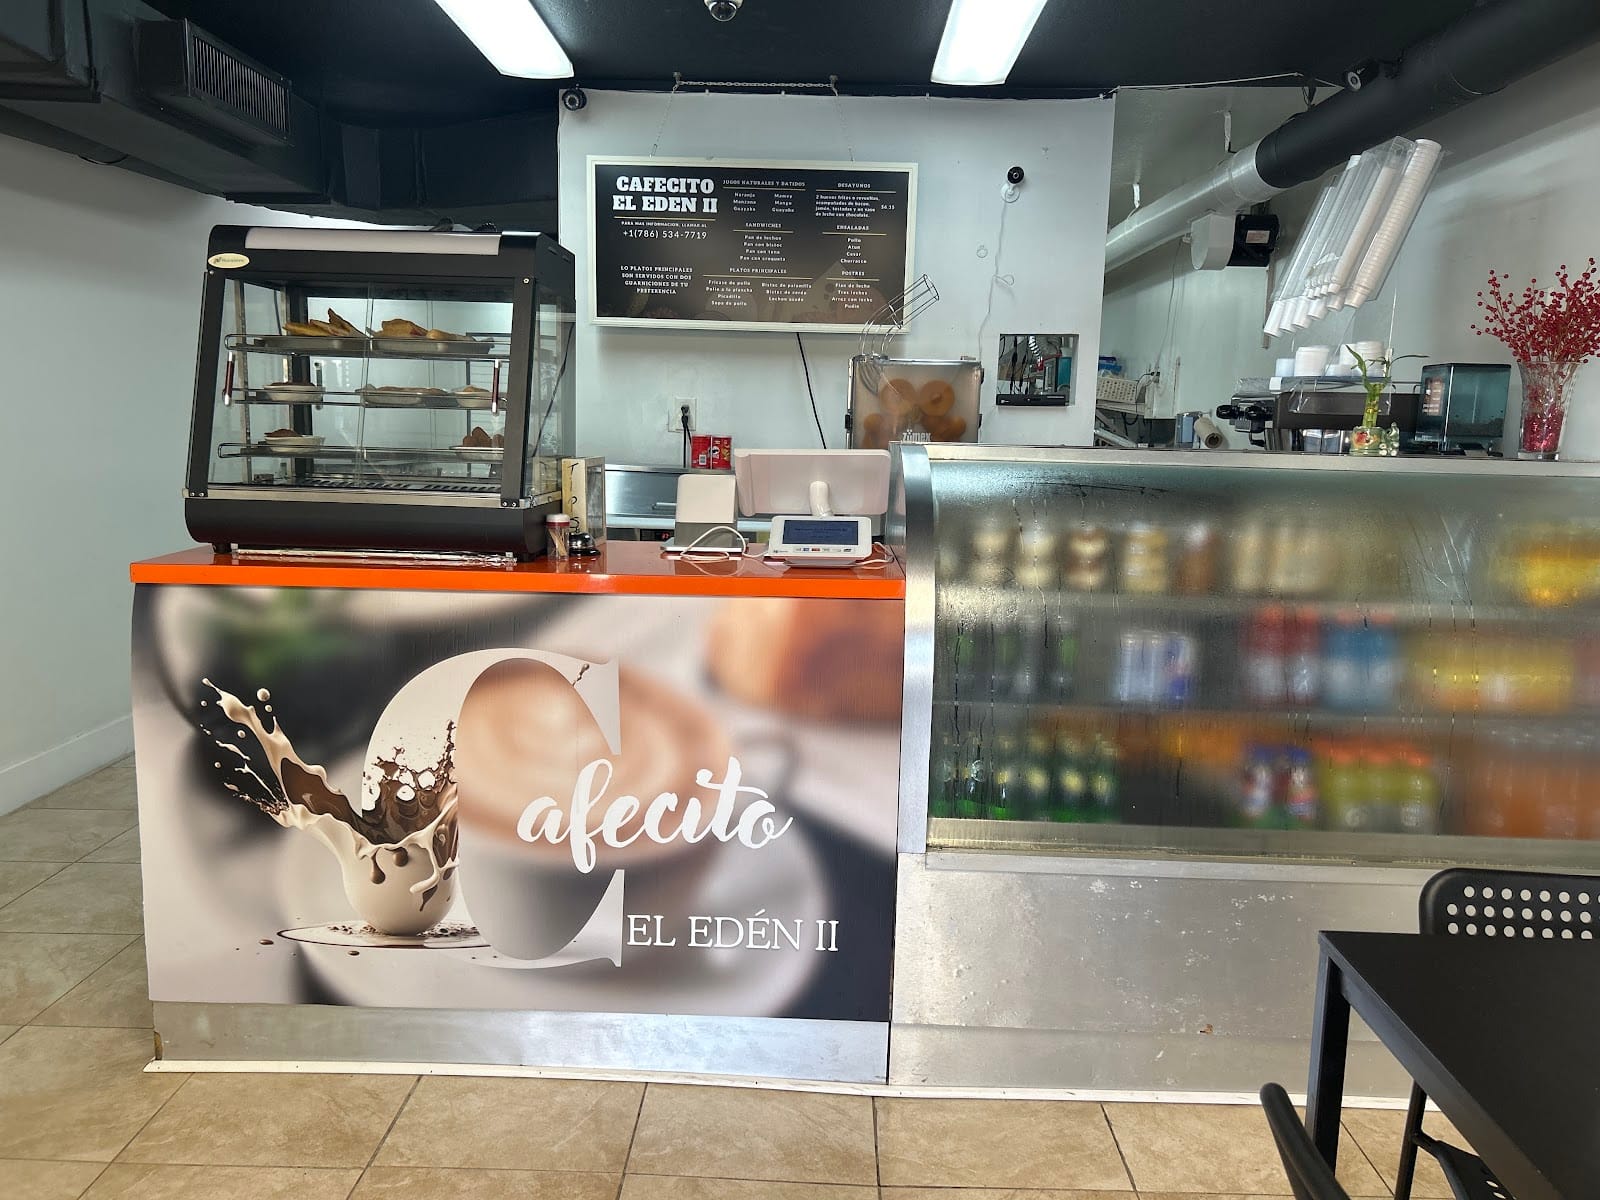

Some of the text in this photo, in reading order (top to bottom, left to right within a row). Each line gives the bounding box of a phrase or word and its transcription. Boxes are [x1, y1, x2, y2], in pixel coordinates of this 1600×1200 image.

[616, 175, 715, 194] CAFECITO
[612, 195, 718, 213] EL EDEN II
[622, 229, 707, 240] +1(786) 534-7719
[627, 909, 839, 952] EL EDÉN II
